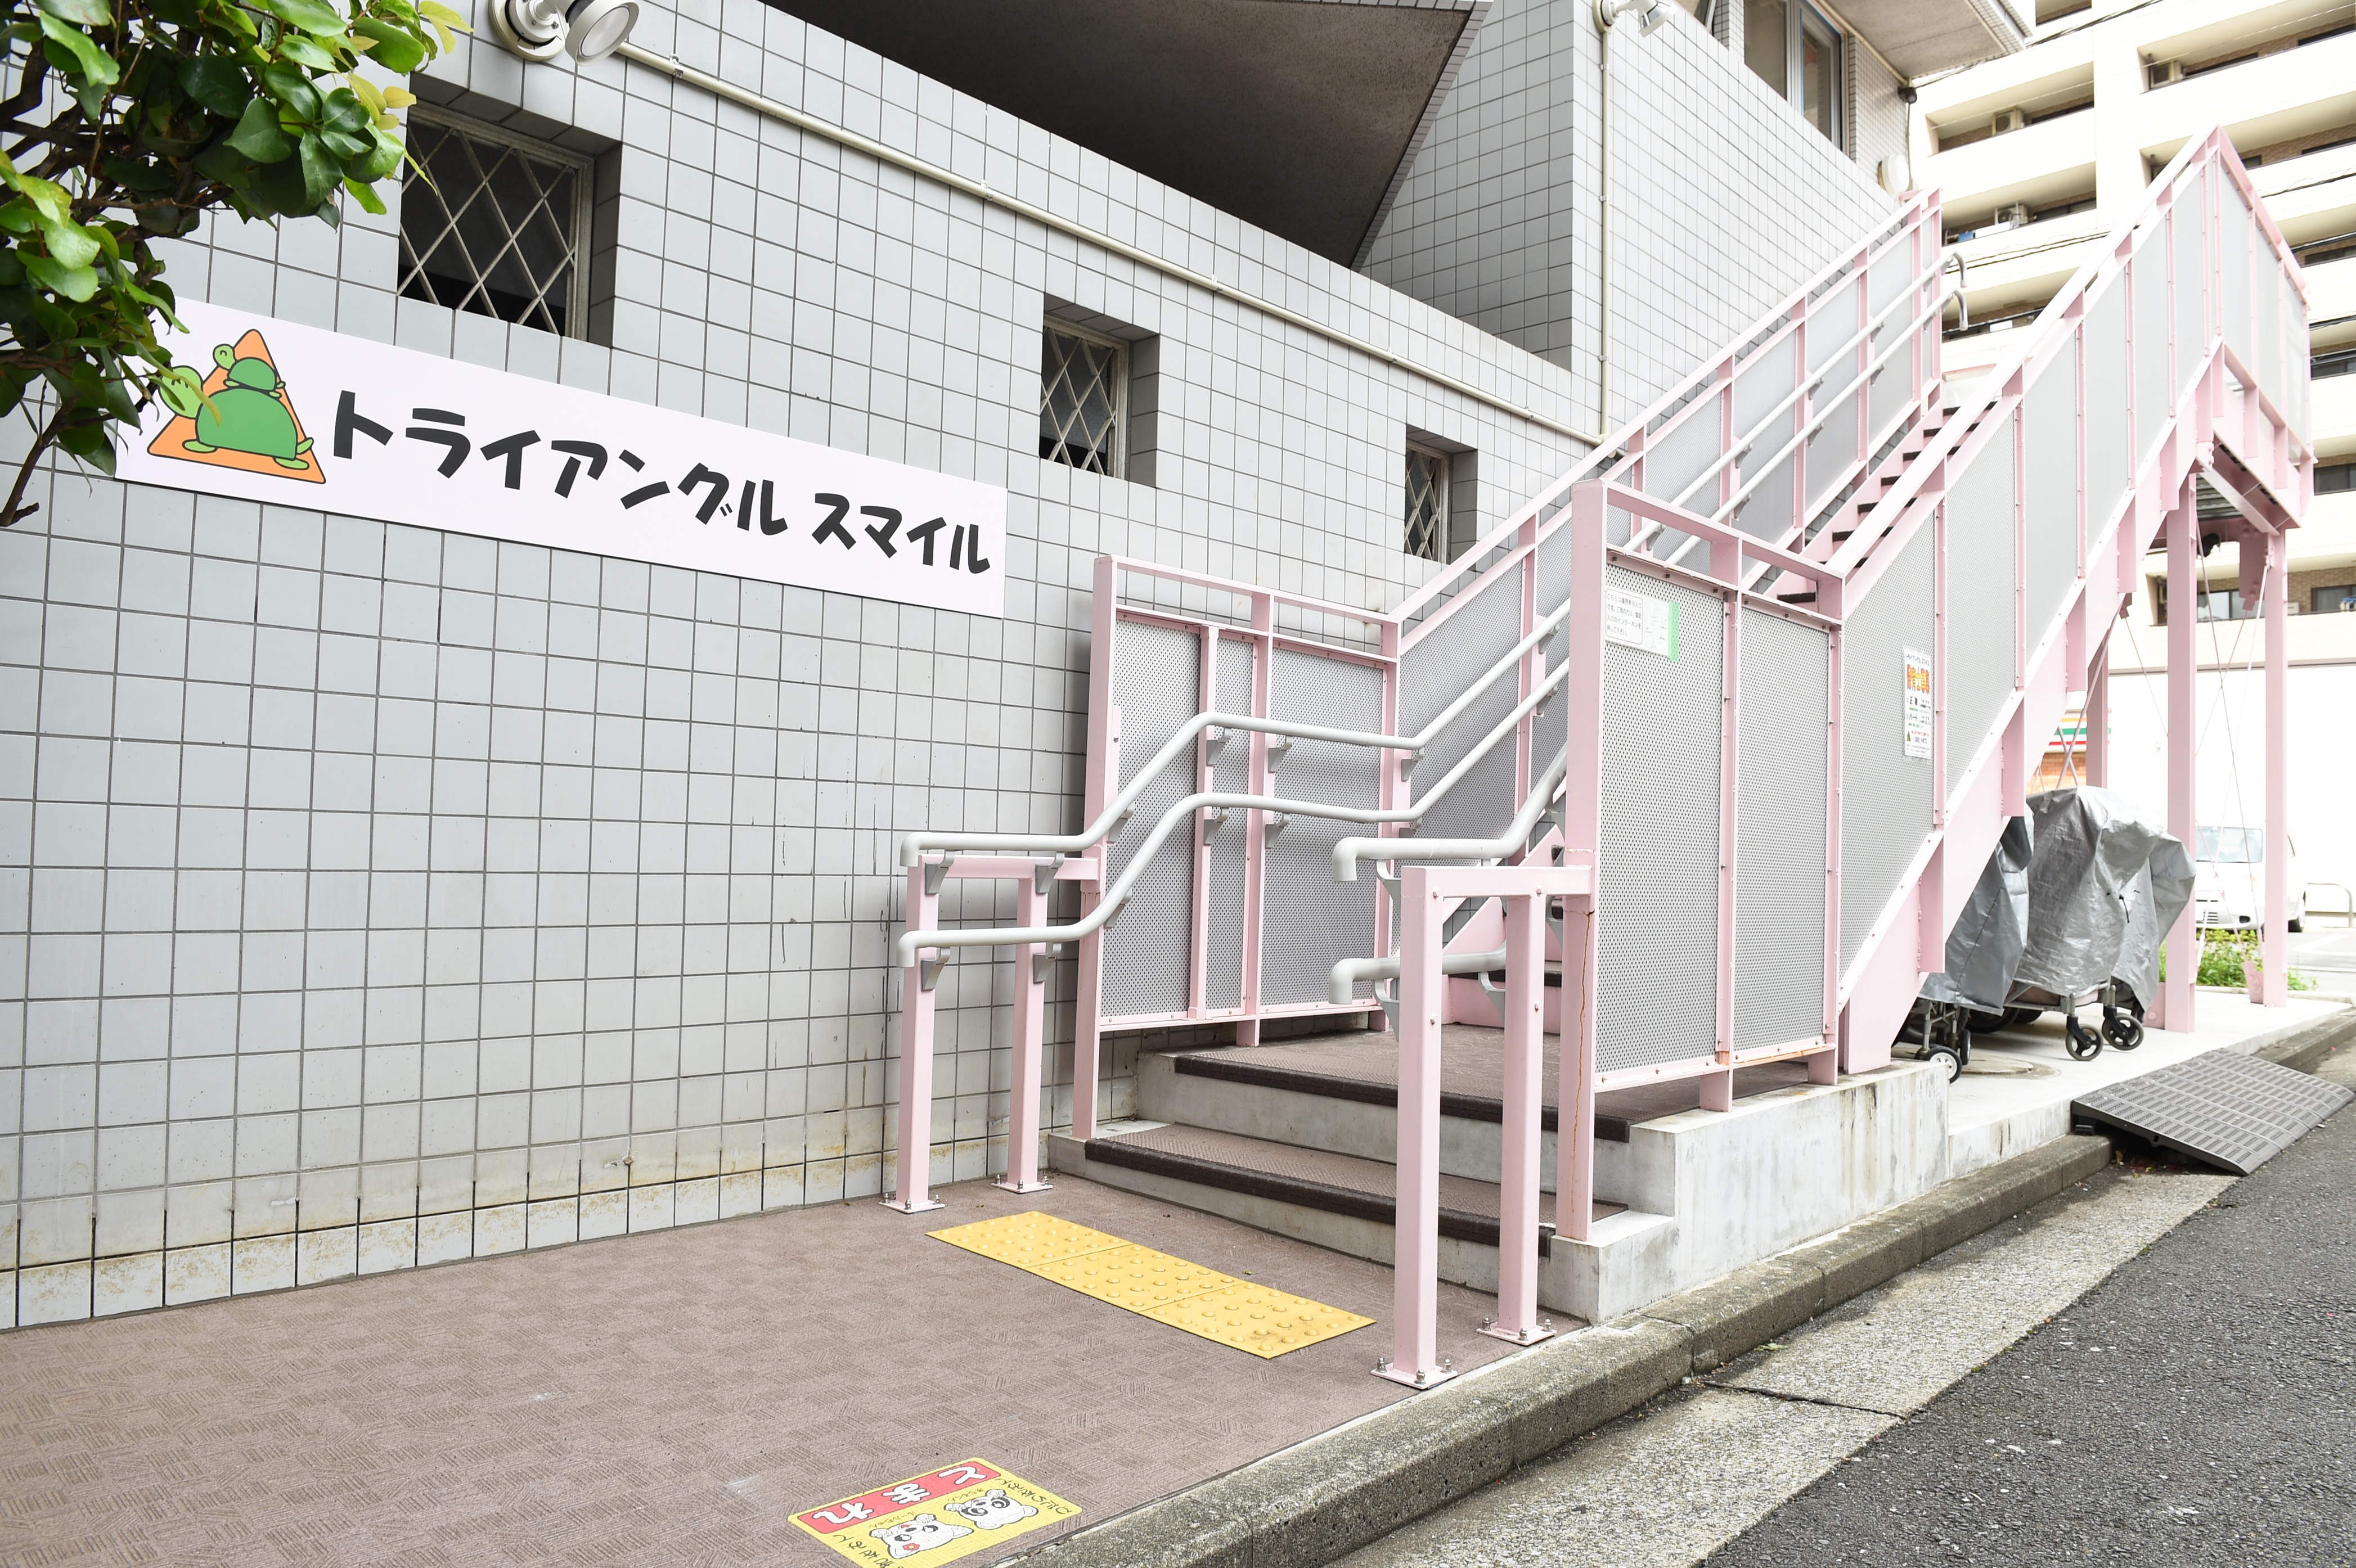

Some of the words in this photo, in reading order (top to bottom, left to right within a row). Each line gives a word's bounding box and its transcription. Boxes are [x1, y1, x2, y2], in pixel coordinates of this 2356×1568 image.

[334, 390, 788, 537] トライアングル
[811, 493, 991, 574] スマイル
[813, 1466, 987, 1524] とまれ
[994, 1477, 1072, 1515] ひだりをみて
